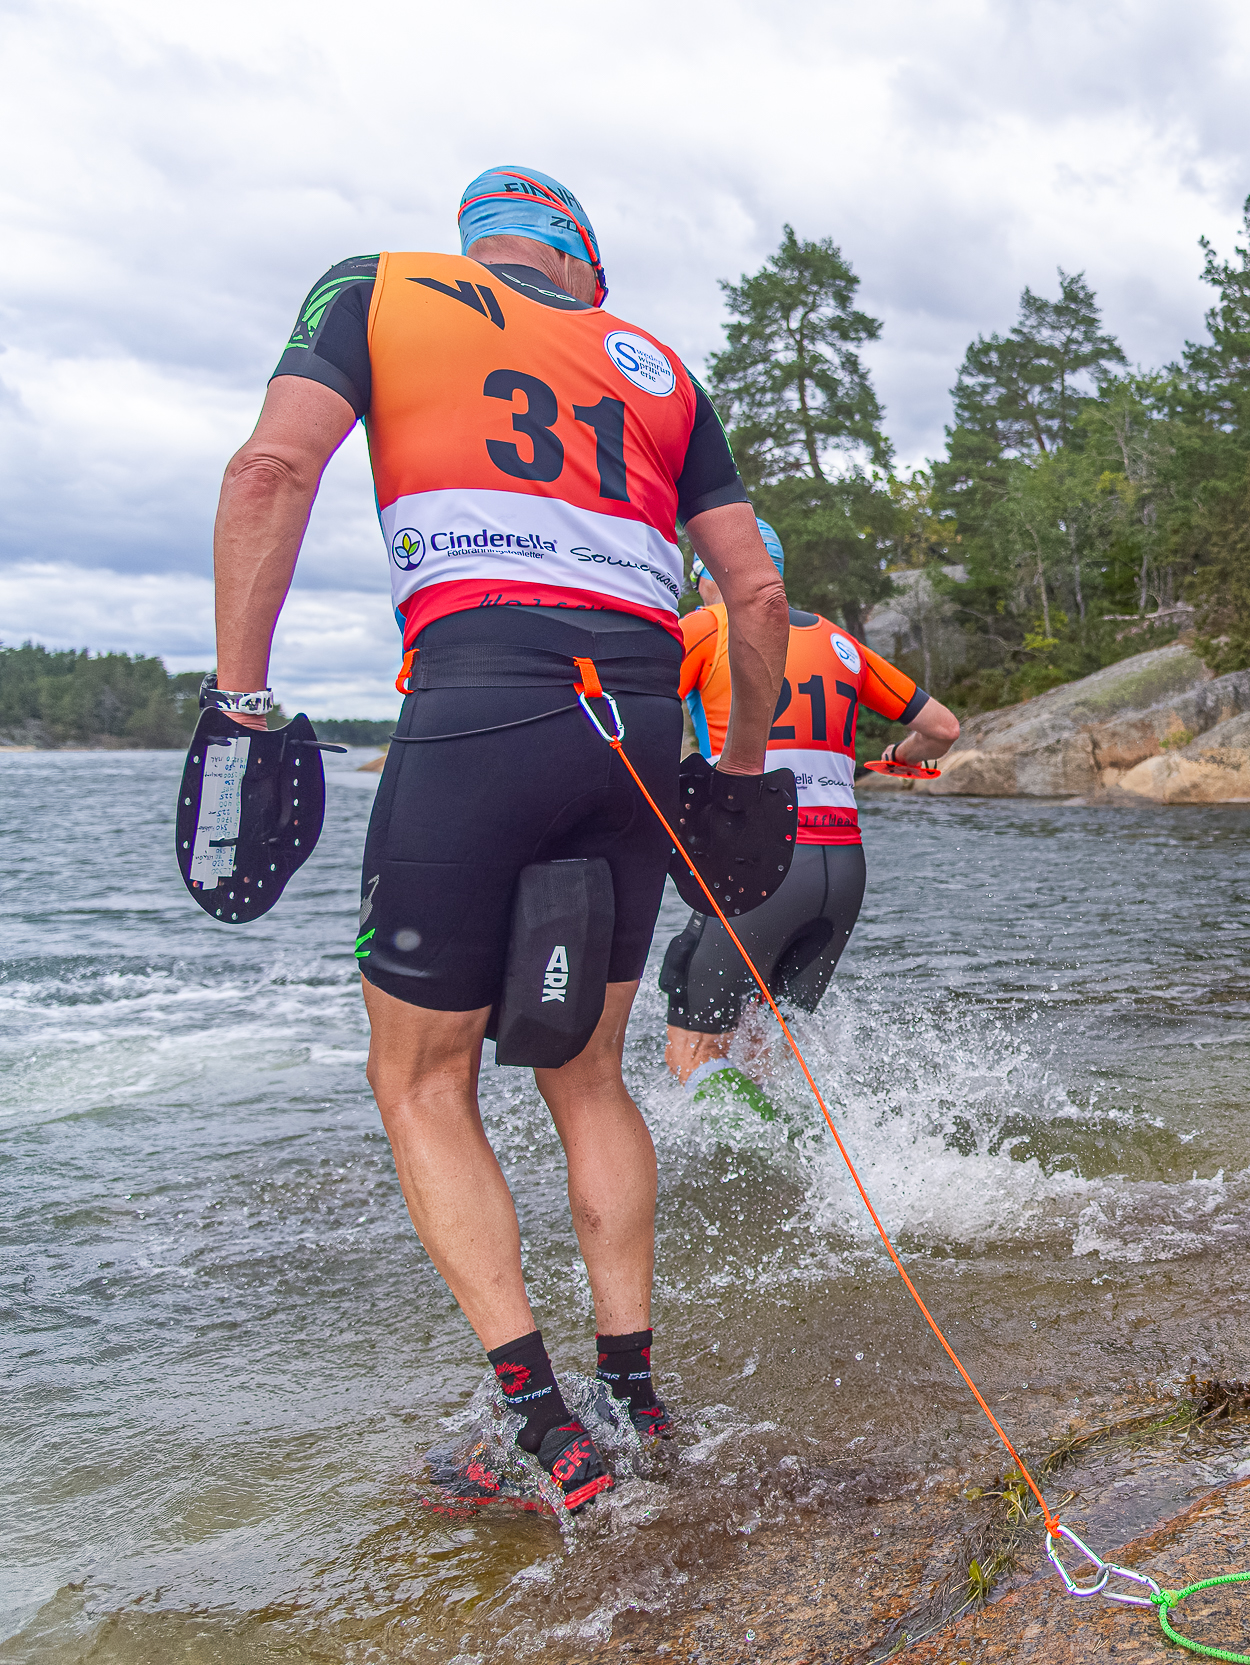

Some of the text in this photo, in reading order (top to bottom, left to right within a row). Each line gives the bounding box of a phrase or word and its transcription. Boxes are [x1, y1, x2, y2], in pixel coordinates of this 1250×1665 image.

[483, 368, 631, 503] 31
[768, 674, 858, 747] 217
[541, 945, 569, 1003] ARK
